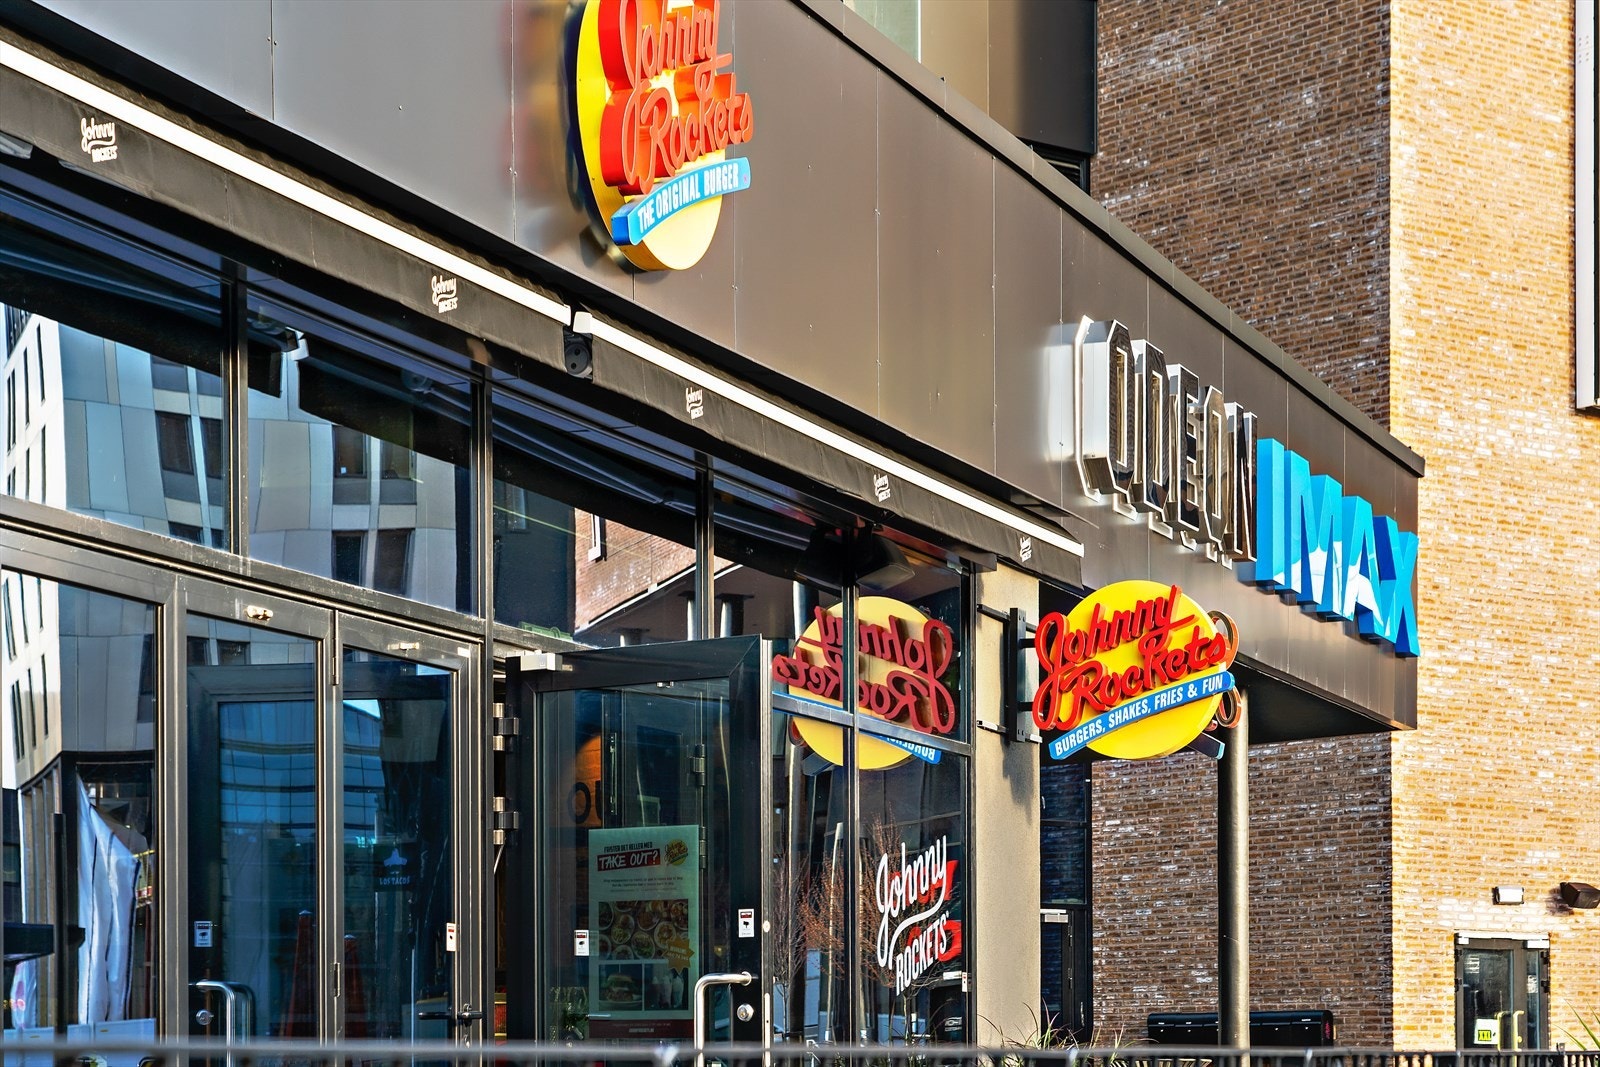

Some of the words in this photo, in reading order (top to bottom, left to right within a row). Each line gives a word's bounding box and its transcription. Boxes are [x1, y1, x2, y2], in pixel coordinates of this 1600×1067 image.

[80, 117, 116, 154] Johnny
[619, 0, 733, 186] Johnny
[639, 72, 753, 195] Rockets
[636, 204, 656, 233] THE
[655, 185, 701, 216] ORIGINAL
[703, 162, 739, 197] BURGER
[1105, 318, 1258, 563] ODEON
[1256, 438, 1420, 657] IMAX
[1033, 585, 1197, 729] Johnny
[1056, 625, 1227, 730] Rockets
[1054, 720, 1106, 757] BURGERS,
[1108, 697, 1151, 727] SHAKES,
[1154, 687, 1184, 709] FRIES
[1187, 683, 1198, 699] &
[1202, 675, 1223, 693] FUN
[599, 854, 626, 870] TAKE
[630, 850, 659, 867] OUT?
[875, 834, 947, 971] Johnny
[896, 914, 949, 997] ROCKETS
